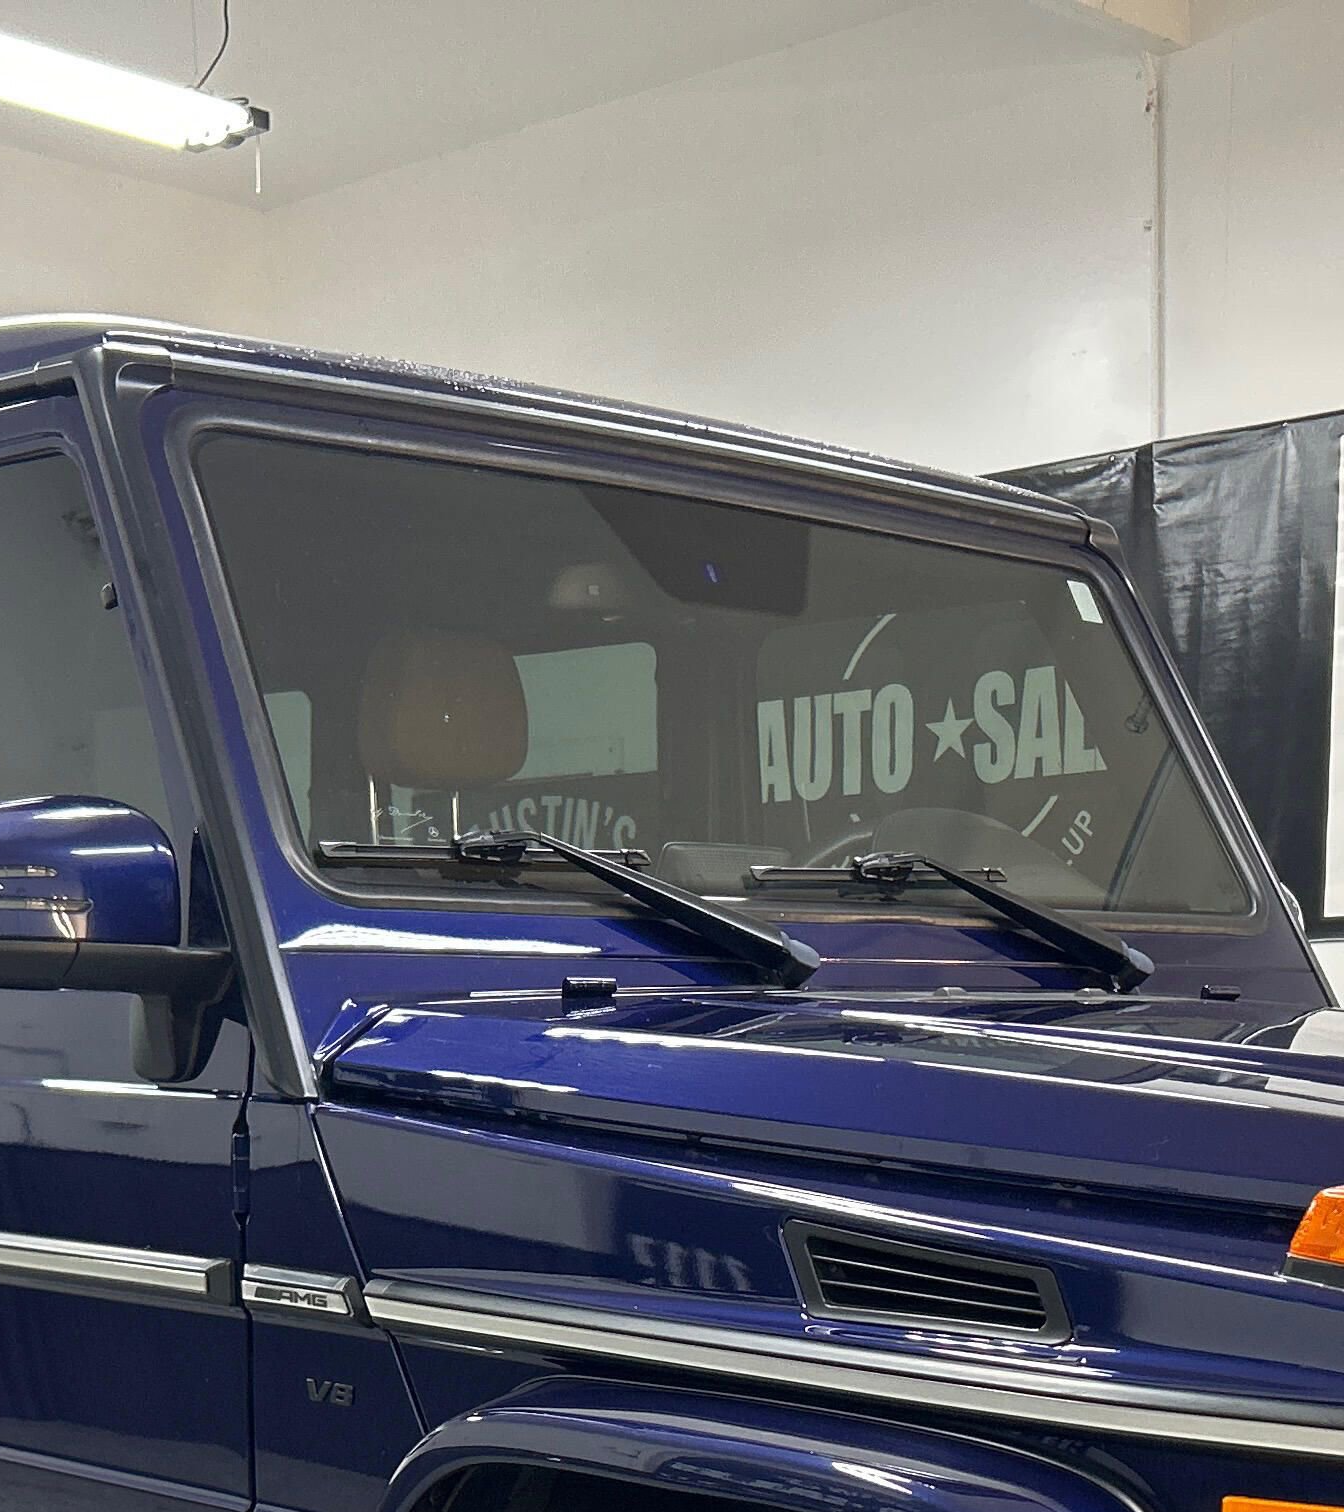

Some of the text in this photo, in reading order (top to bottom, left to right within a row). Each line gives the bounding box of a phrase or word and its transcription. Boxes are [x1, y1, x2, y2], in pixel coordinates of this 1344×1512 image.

[757, 664, 1107, 803] AUTO SAL
[277, 1289, 329, 1309] AMG
[306, 1377, 354, 1407] V8
